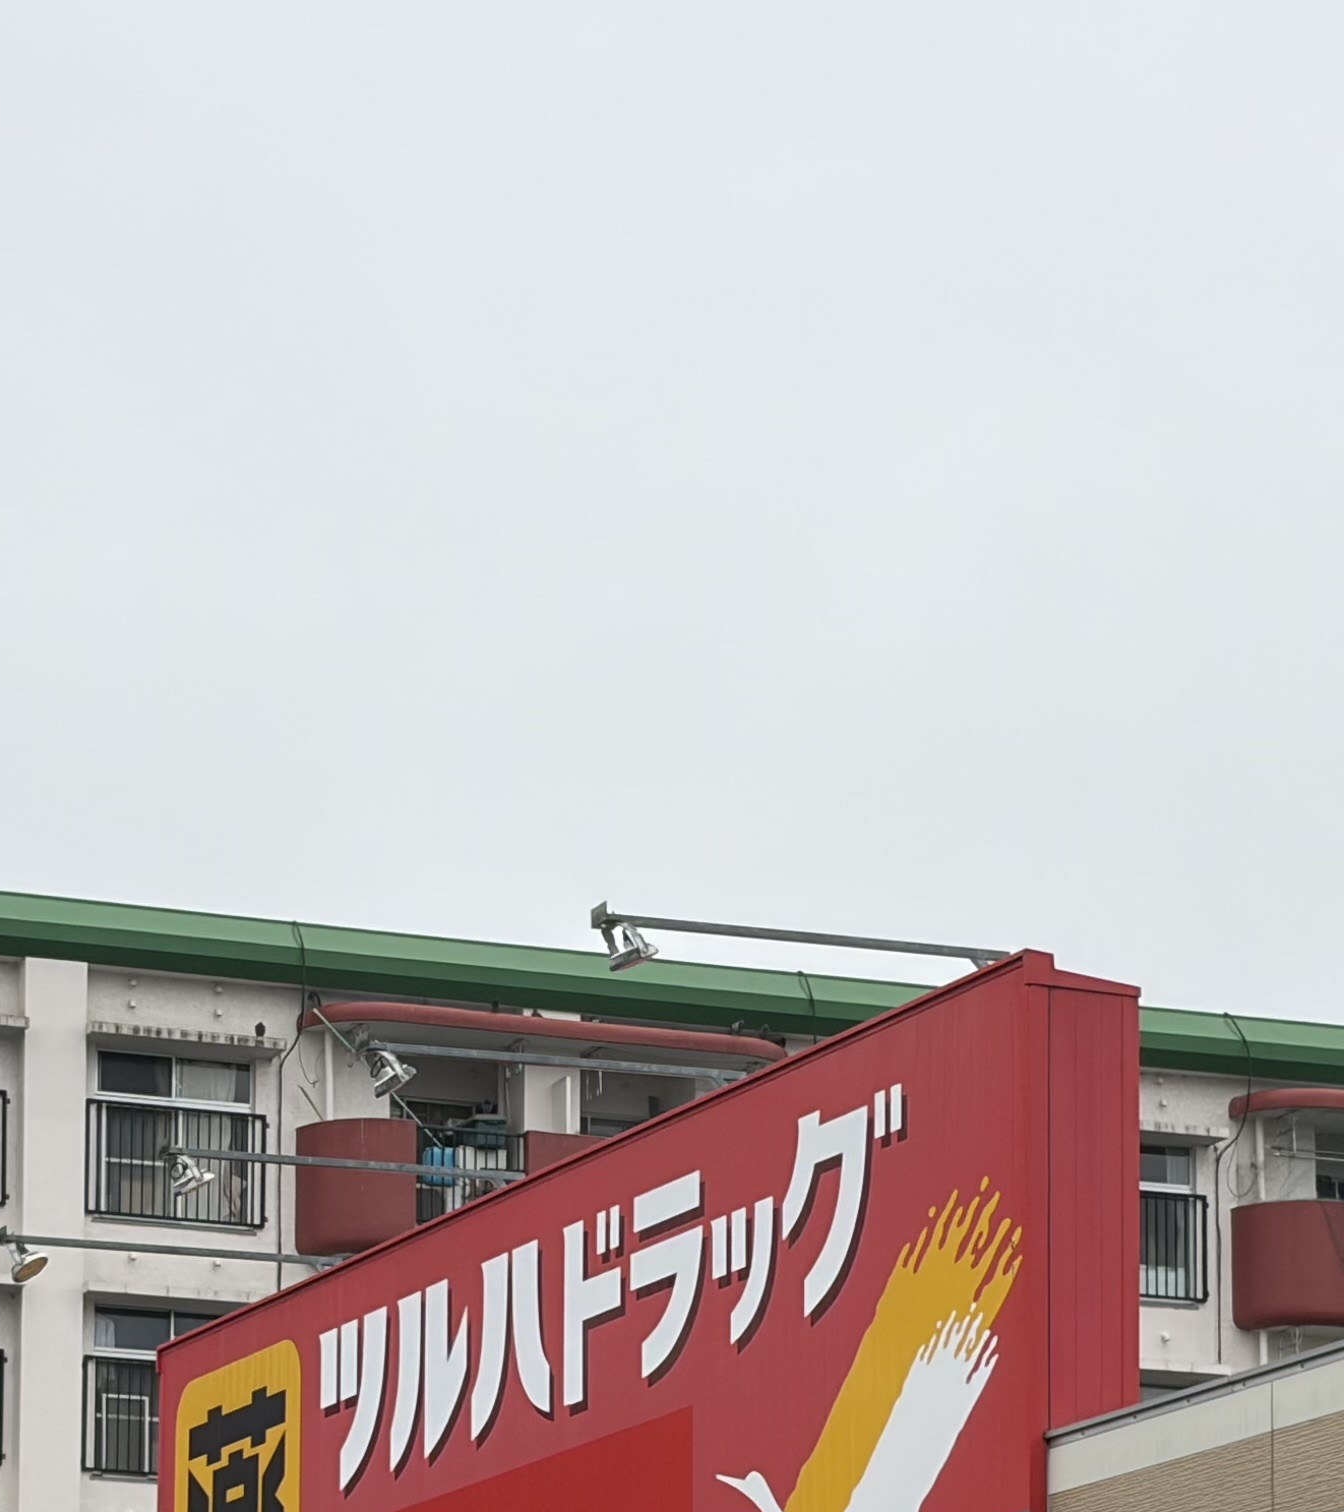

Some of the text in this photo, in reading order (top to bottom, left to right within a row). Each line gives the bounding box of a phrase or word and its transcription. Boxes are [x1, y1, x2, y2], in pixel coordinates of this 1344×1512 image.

[317, 1082, 907, 1493] ツルハドラッグ
